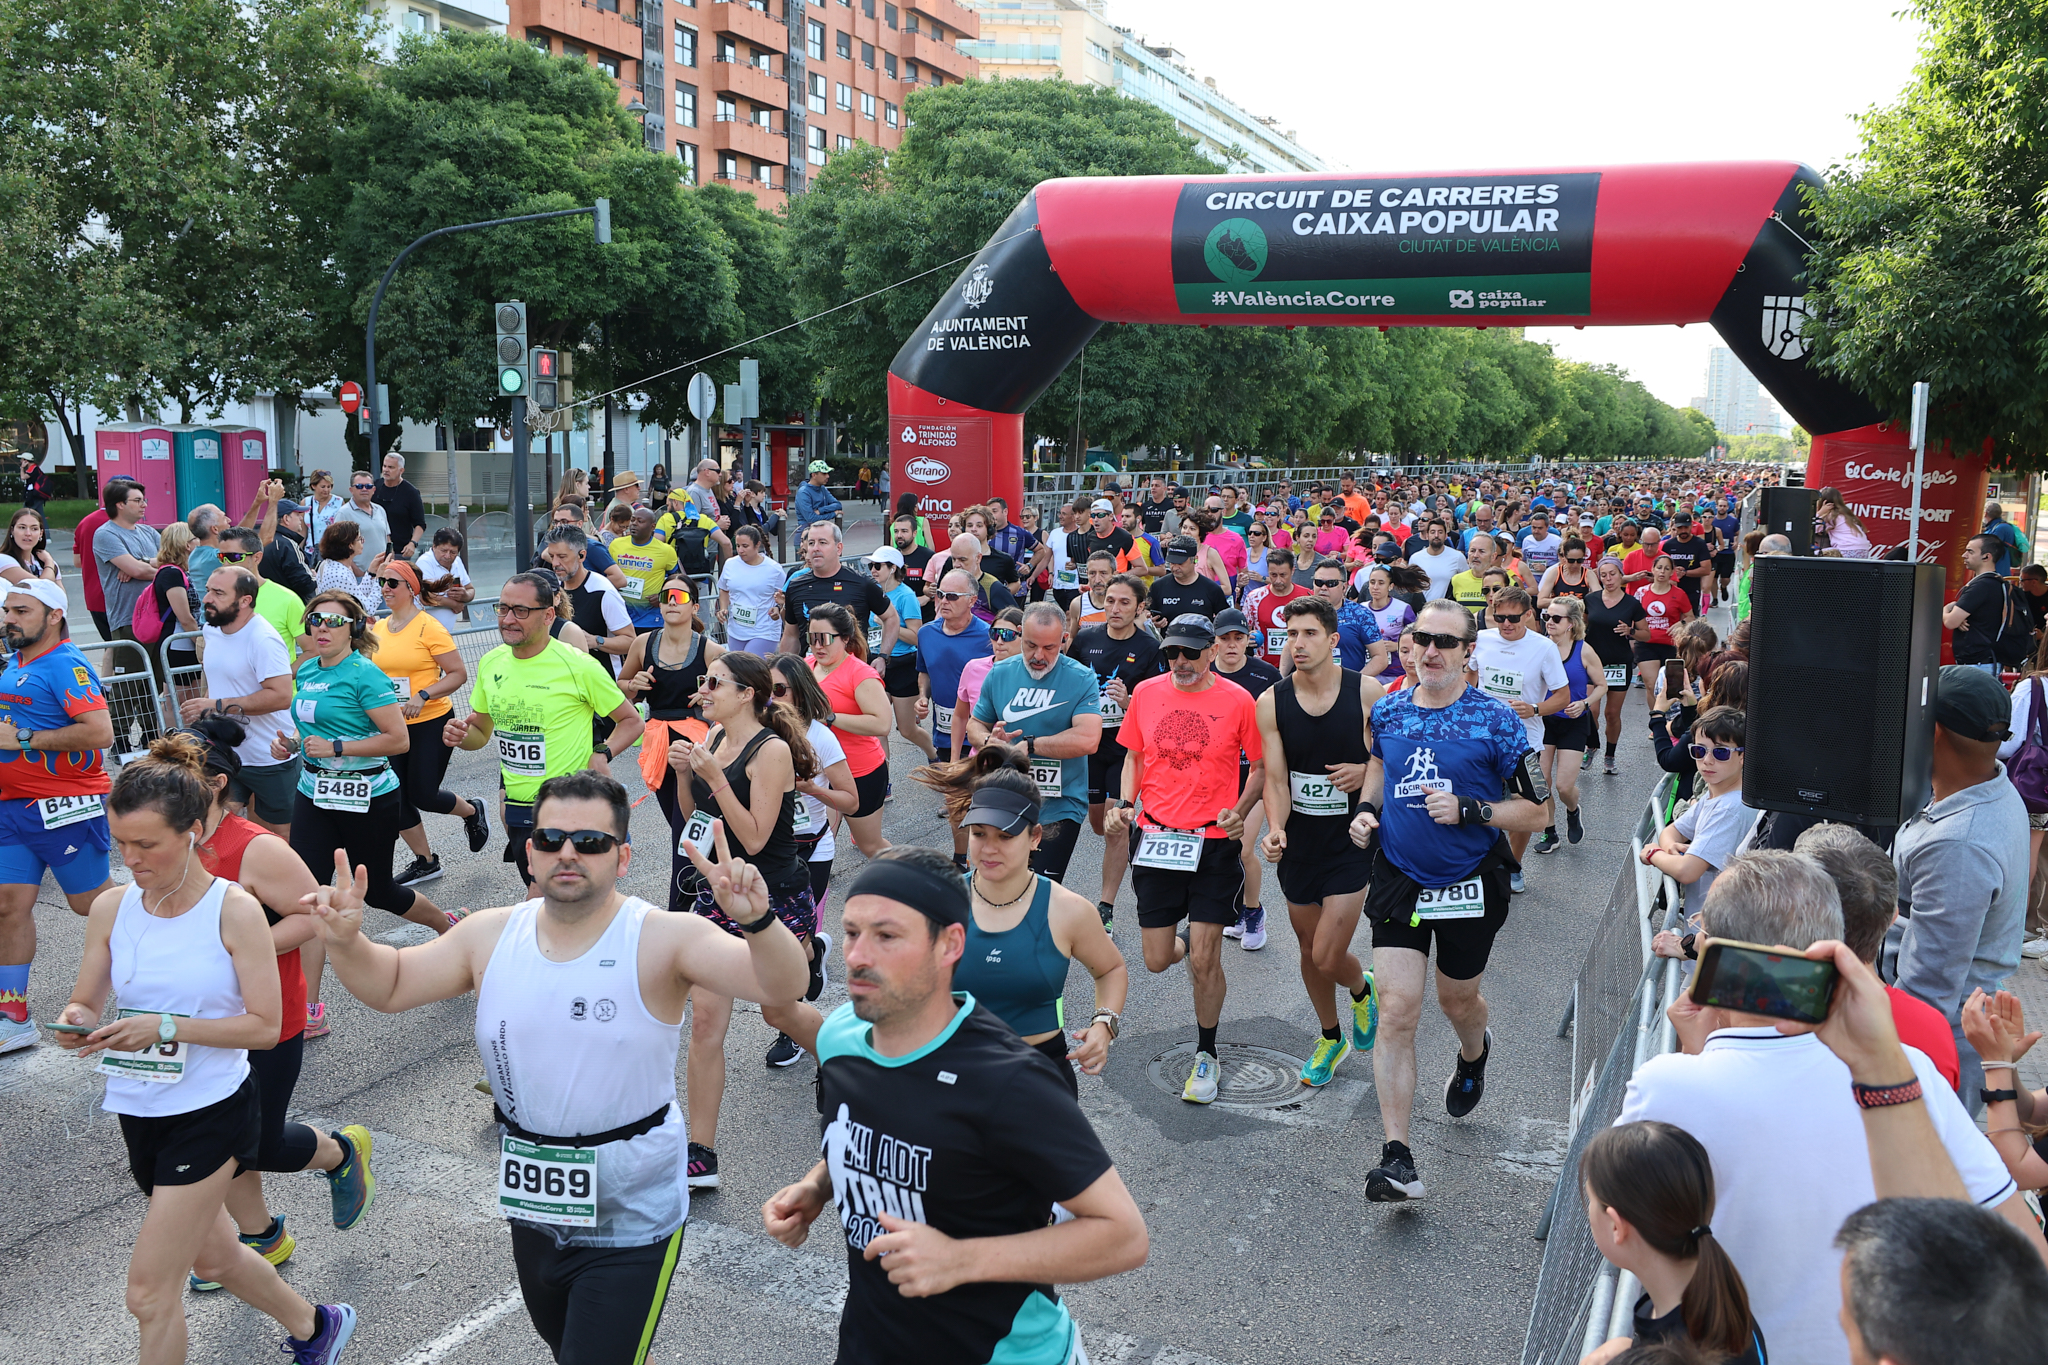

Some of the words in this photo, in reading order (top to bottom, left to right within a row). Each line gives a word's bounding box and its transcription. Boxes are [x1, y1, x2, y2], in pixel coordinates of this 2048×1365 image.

[1205, 190, 1324, 210] CIRCUIT
[1330, 188, 1373, 208] DE
[1378, 184, 1560, 207] CARRERES
[1399, 239, 1446, 254] CIUTAT
[1456, 239, 1477, 252] DE
[1481, 235, 1560, 252] VALÈNCIA
[1212, 290, 1396, 307] #ValènciaCorre
[1478, 290, 1522, 300] caixa
[1478, 299, 1546, 308] popular
[930, 316, 1028, 334] AJUNTAMENT
[927, 338, 944, 350] DE
[950, 332, 1031, 350] VALÈNCIA
[918, 430, 957, 439] TRINIDAD
[910, 464, 946, 476] Serrano
[1845, 461, 1860, 478] El
[1860, 464, 1901, 482] Corte
[1902, 462, 1958, 489] Iglés
[1853, 503, 1953, 522] INTERSPORT
[618, 558, 653, 568] runners
[736, 607, 751, 618] 708
[1270, 637, 1288, 646] 67
[1492, 674, 1514, 686] 419
[1011, 687, 1056, 708] RUN
[500, 740, 540, 761] 6516
[318, 780, 368, 797] 5488
[1301, 784, 1334, 797] 427
[1398, 786, 1409, 795] 16
[1798, 790, 1823, 799] QSC
[1146, 841, 1193, 858] 7812
[491, 1040, 502, 1062] FONS
[497, 1064, 507, 1087] GRAN
[502, 1053, 512, 1090] MANOLO
[876, 1134, 932, 1191] ADT
[504, 1159, 590, 1198] 6969
